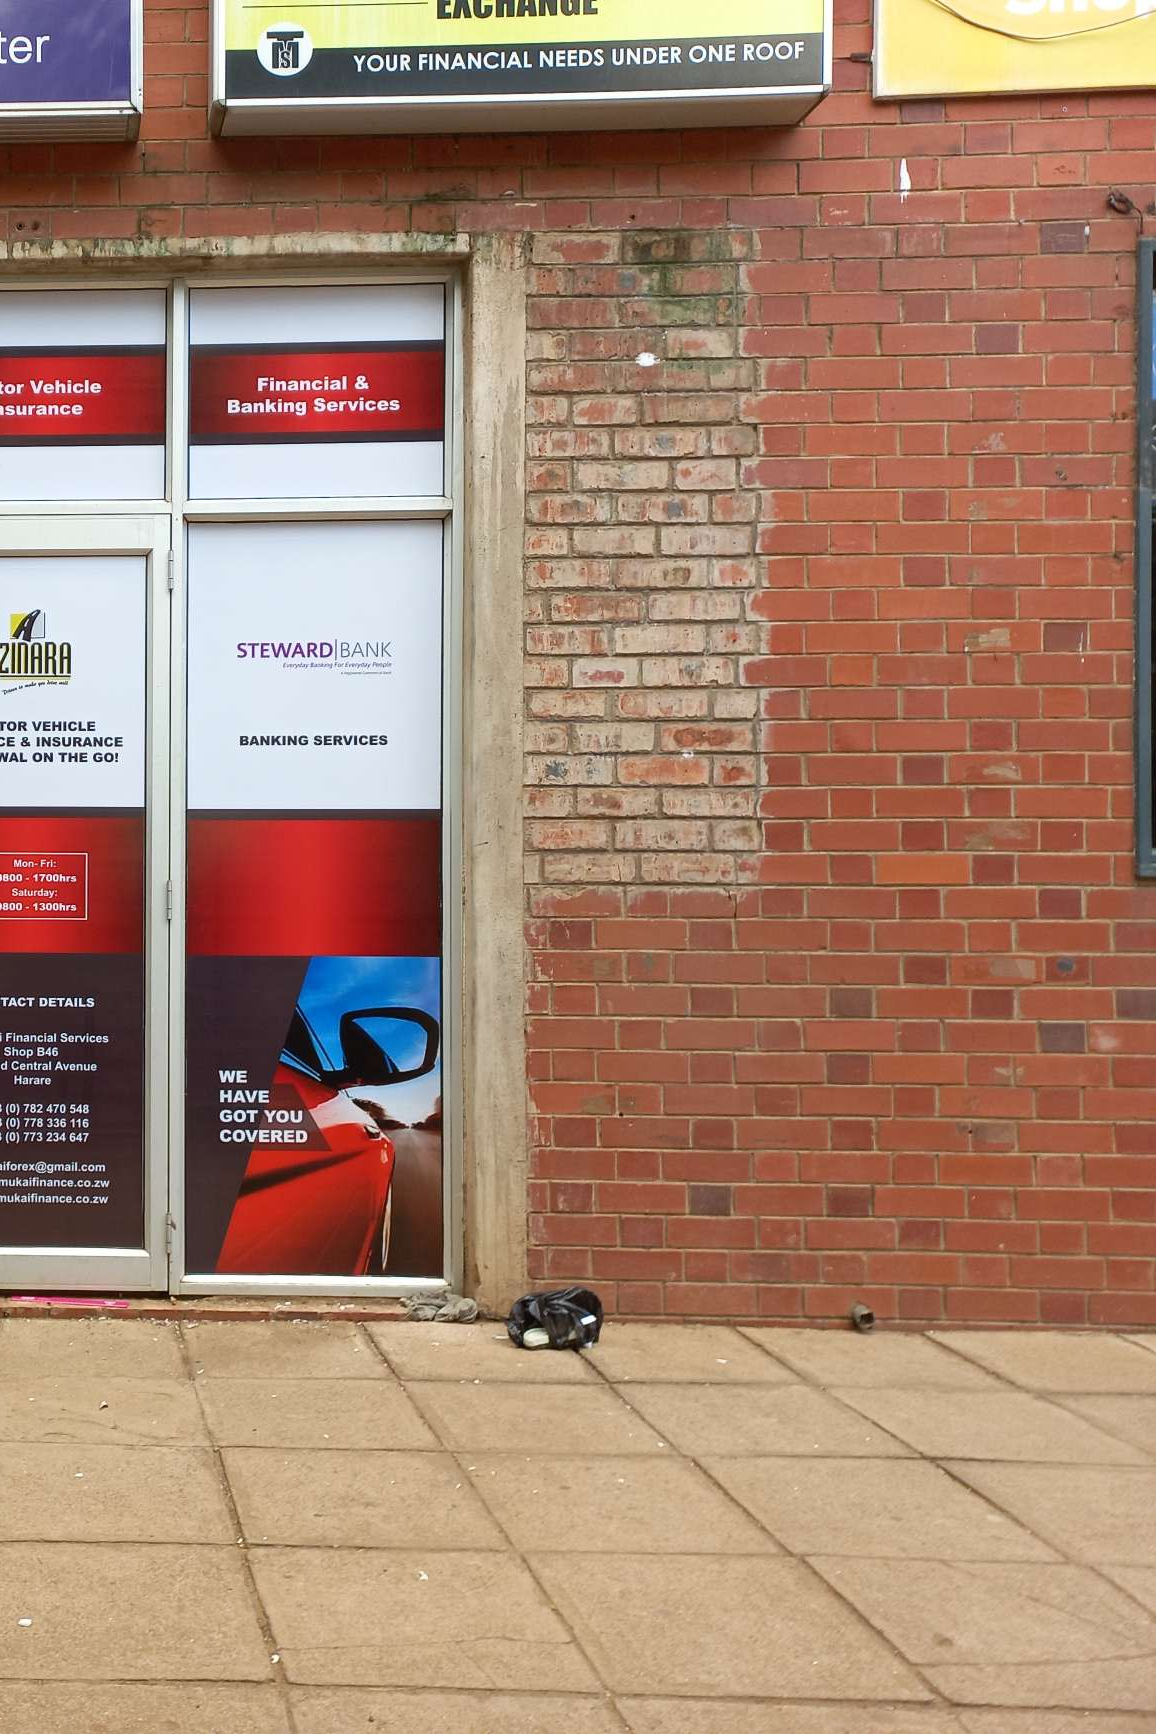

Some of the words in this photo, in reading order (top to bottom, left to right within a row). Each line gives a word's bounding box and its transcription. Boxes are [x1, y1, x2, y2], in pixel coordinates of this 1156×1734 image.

[353, 54, 411, 73] YOUR
[419, 49, 533, 71] FINANCIAL
[539, 48, 605, 68] NEEDS
[612, 46, 682, 66] UNDER
[689, 43, 736, 64] ONE
[743, 41, 805, 62] ROOF
[30, 379, 102, 394] Vehicle
[257, 376, 348, 392] Financial
[354, 375, 370, 390] &
[227, 399, 307, 416] Banking
[313, 397, 401, 413] Services
[236, 642, 333, 658] STEWARD
[340, 641, 392, 658] BANK
[32, 721, 96, 732] VEHICLE
[20, 736, 31, 748] &
[36, 736, 124, 748] INSURANCE
[239, 735, 309, 746] BANKING
[313, 735, 388, 746] SERVICES
[32, 752, 54, 763] ON
[58, 752, 88, 763] THE
[92, 752, 119, 763] GO!
[13, 859, 38, 868] Mon-
[40, 859, 57, 868] Fri:
[32, 873, 77, 882] 1700hrs
[11, 888, 58, 899] Saturday:
[32, 902, 77, 911] 1300hrs
[39, 998, 95, 1007] DETAILS
[5, 1032, 57, 1043] Financial
[60, 1033, 109, 1043] Services
[3, 1047, 34, 1058] Shop
[37, 1047, 59, 1057] B46
[11, 1060, 52, 1071] Central
[54, 1061, 98, 1071] Avenue
[13, 1075, 52, 1085] Harare
[218, 1070, 248, 1083] WE
[219, 1090, 270, 1103] HAVE
[5, 1104, 20, 1115] (0)
[23, 1104, 43, 1113] 782
[46, 1104, 66, 1114] 470
[69, 1104, 90, 1114] 548
[219, 1109, 259, 1123] GOT
[264, 1110, 303, 1123] YOU
[5, 1118, 20, 1129] (0)
[23, 1118, 43, 1128] 778
[46, 1118, 66, 1128] 336
[70, 1119, 90, 1128] 116
[5, 1132, 20, 1144] (0)
[23, 1132, 43, 1142] 773
[46, 1133, 66, 1142] 234
[69, 1133, 90, 1142] 647
[219, 1129, 308, 1143] COVERED
